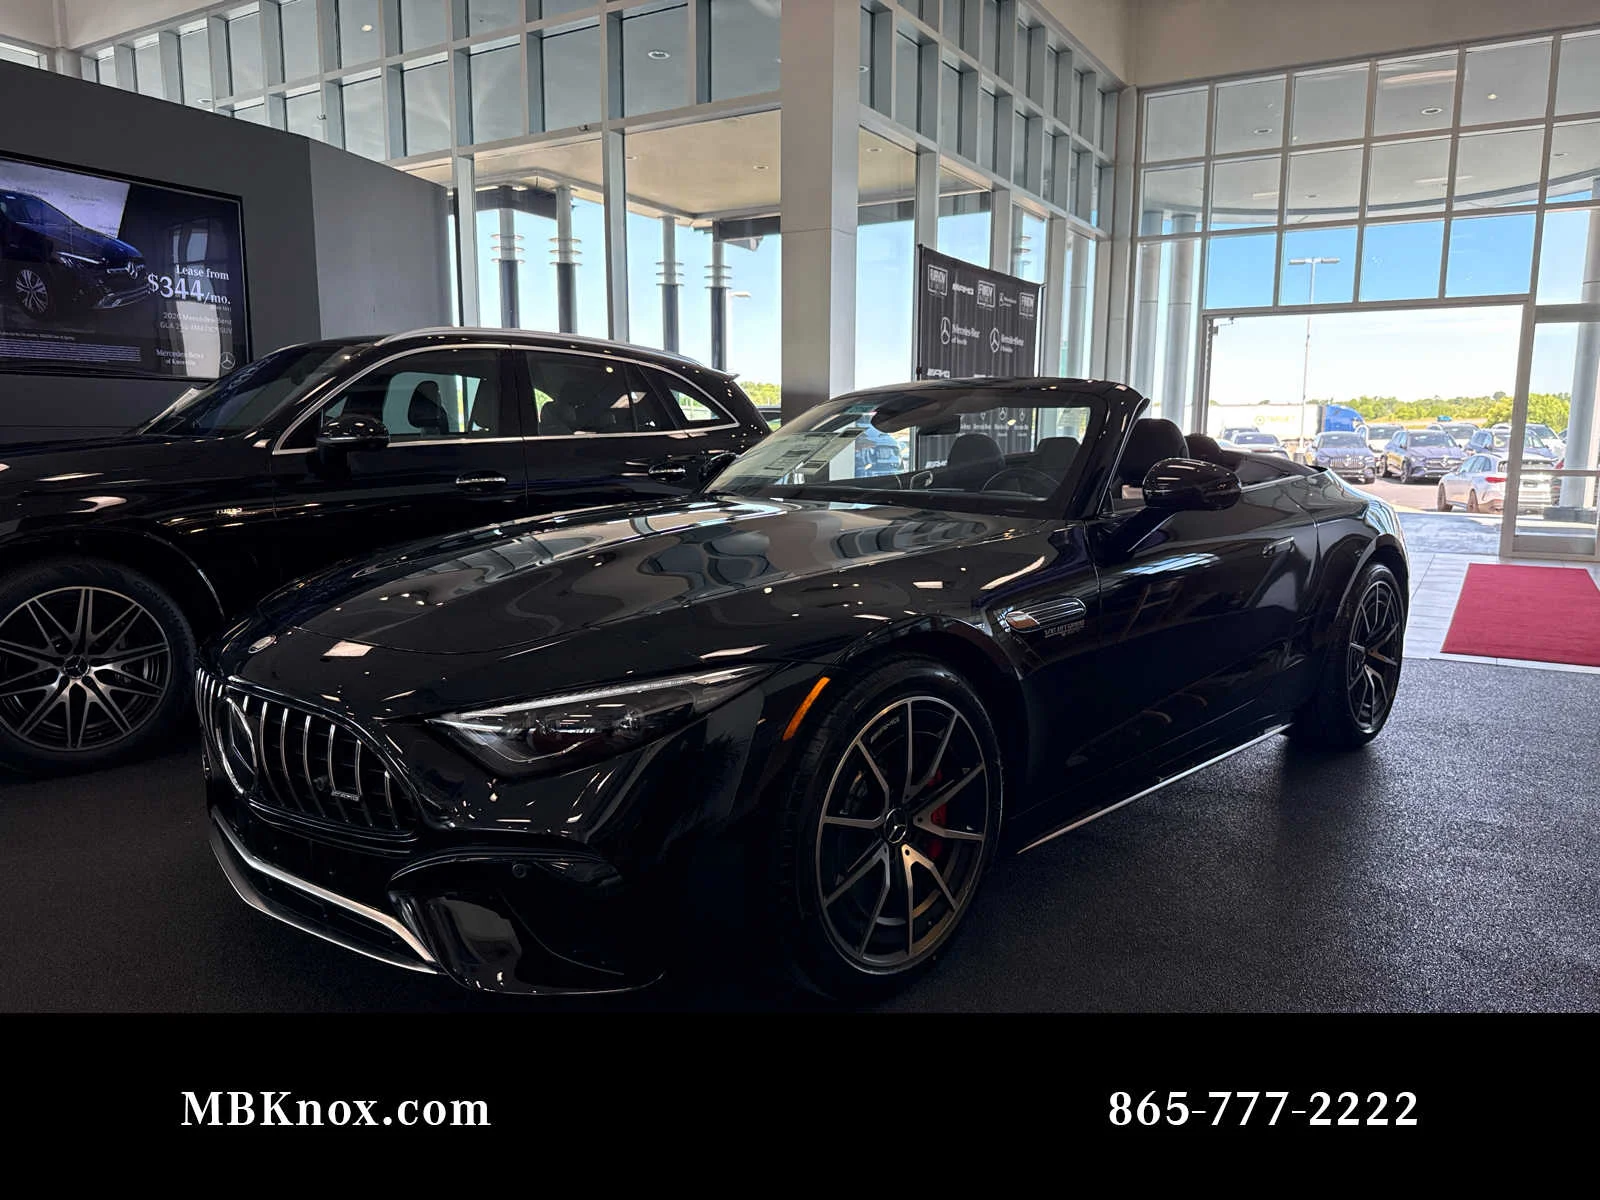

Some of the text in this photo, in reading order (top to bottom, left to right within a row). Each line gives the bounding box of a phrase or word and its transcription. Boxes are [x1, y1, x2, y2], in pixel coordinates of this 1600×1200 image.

[176, 264, 230, 281] Lease from
[147, 272, 231, 305] $344/mo.
